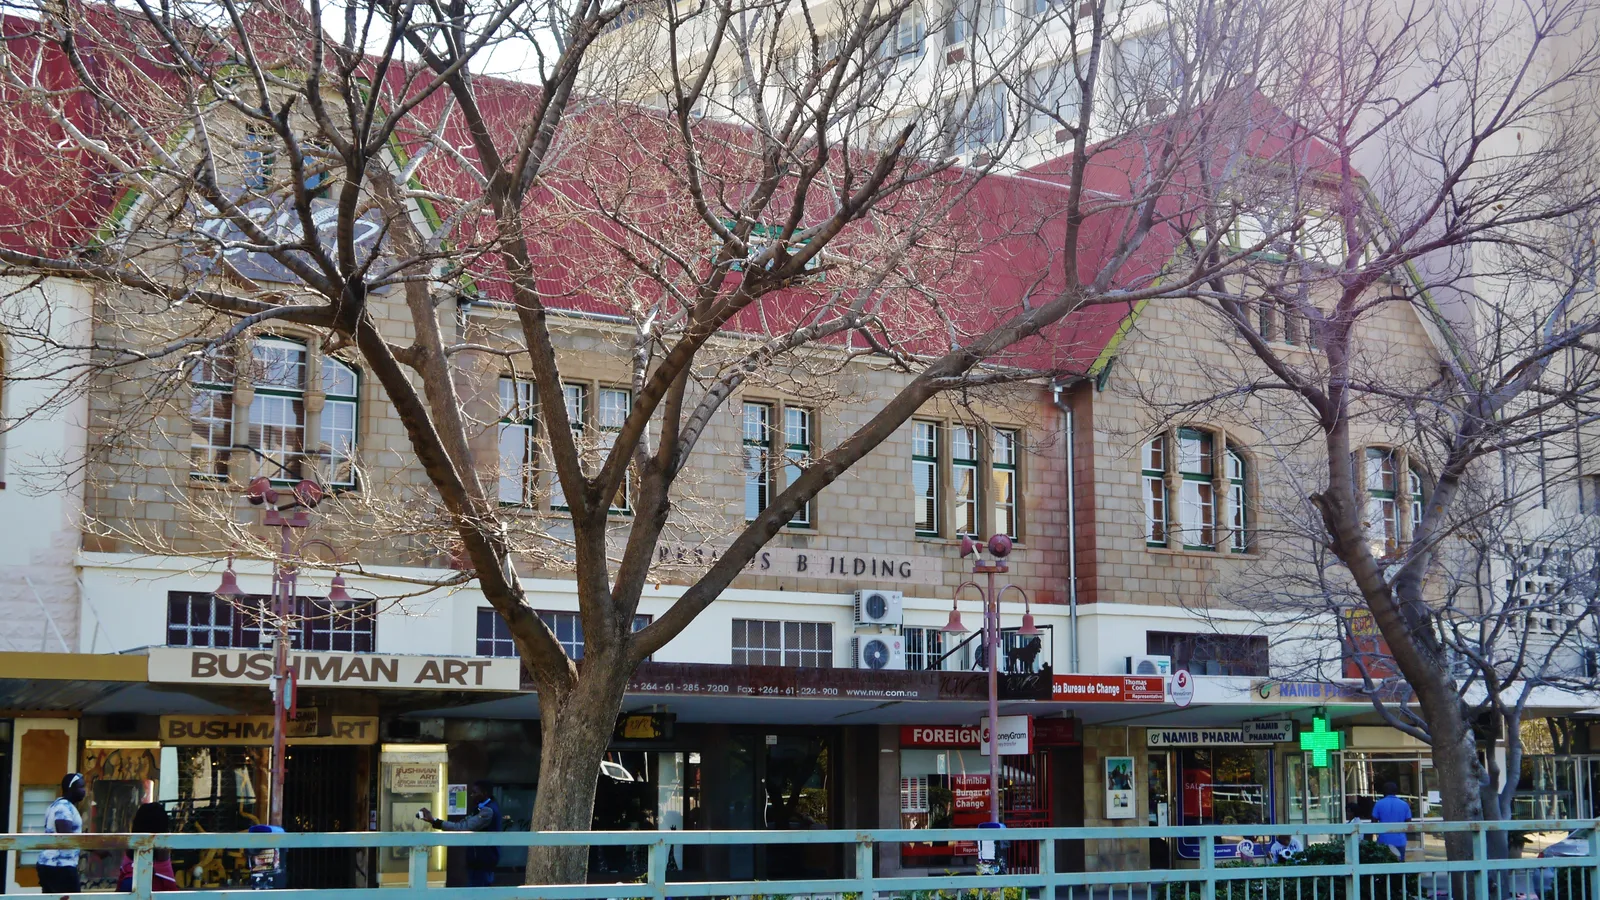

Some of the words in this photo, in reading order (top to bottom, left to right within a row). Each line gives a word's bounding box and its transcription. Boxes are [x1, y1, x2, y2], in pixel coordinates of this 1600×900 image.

[191, 652, 398, 682] BUSHMAN
[414, 660, 492, 685] ART
[1125, 679, 1147, 687] Thomas
[641, 682, 657, 691] 264
[665, 683, 674, 691] 61
[683, 683, 699, 692] 285
[707, 684, 729, 693] 7200
[737, 685, 755, 694] Fax:
[757, 685, 779, 695] +264
[787, 687, 795, 695] 61
[802, 687, 818, 696] 224
[824, 687, 838, 697] 900
[846, 688, 918, 697] www.nwr.com.na
[1063, 683, 1085, 694] Bureau
[1087, 683, 1095, 695] de
[1097, 683, 1120, 696] Change
[1279, 683, 1321, 698] NAMIB
[286, 711, 316, 722] BSHMAN
[169, 720, 274, 740] BUSHM
[1255, 721, 1278, 733] NAMIB
[913, 729, 981, 743] FOREIGN
[997, 731, 1026, 742] oneyGram
[1162, 731, 1199, 743] NAMIB
[1202, 732, 1243, 743] PHARM
[1248, 732, 1285, 741] PHARMACY
[956, 776, 987, 785] Namibia
[956, 788, 983, 797] Bureau
[956, 799, 985, 808] Change
